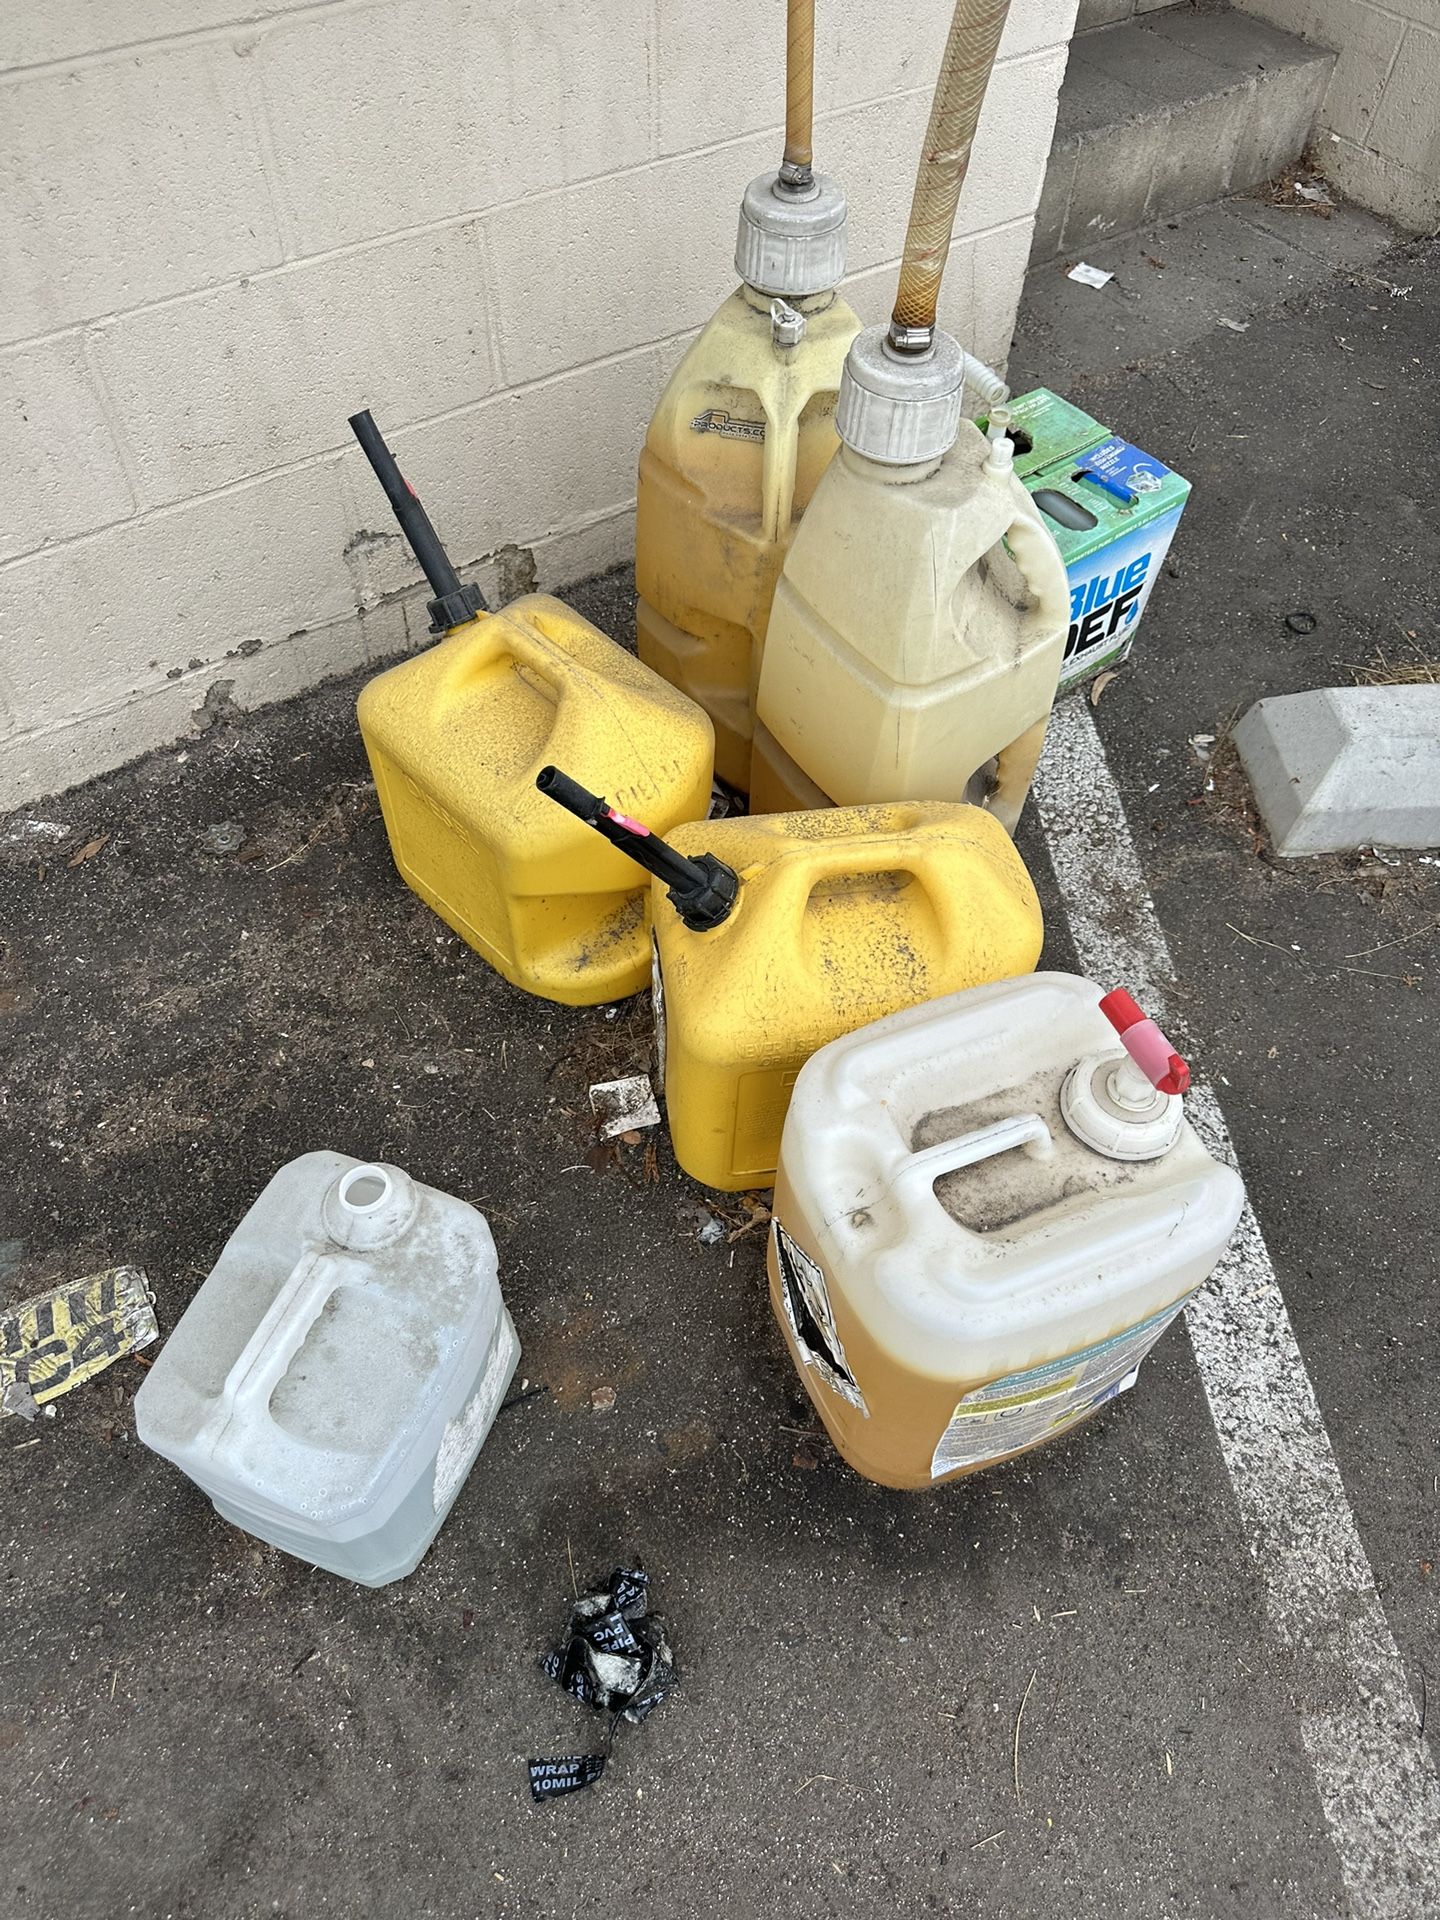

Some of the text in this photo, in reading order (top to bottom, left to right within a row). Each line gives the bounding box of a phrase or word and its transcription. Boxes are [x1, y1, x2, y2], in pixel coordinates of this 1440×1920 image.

[1069, 552, 1151, 623] Blue
[736, 1039, 783, 1060] NEVER
[786, 1036, 816, 1053] USE
[593, 1622, 624, 1641] PVC
[601, 1633, 635, 1653] PIPE
[530, 1763, 580, 1777] WRAP
[533, 1776, 582, 1792] 10MIL
